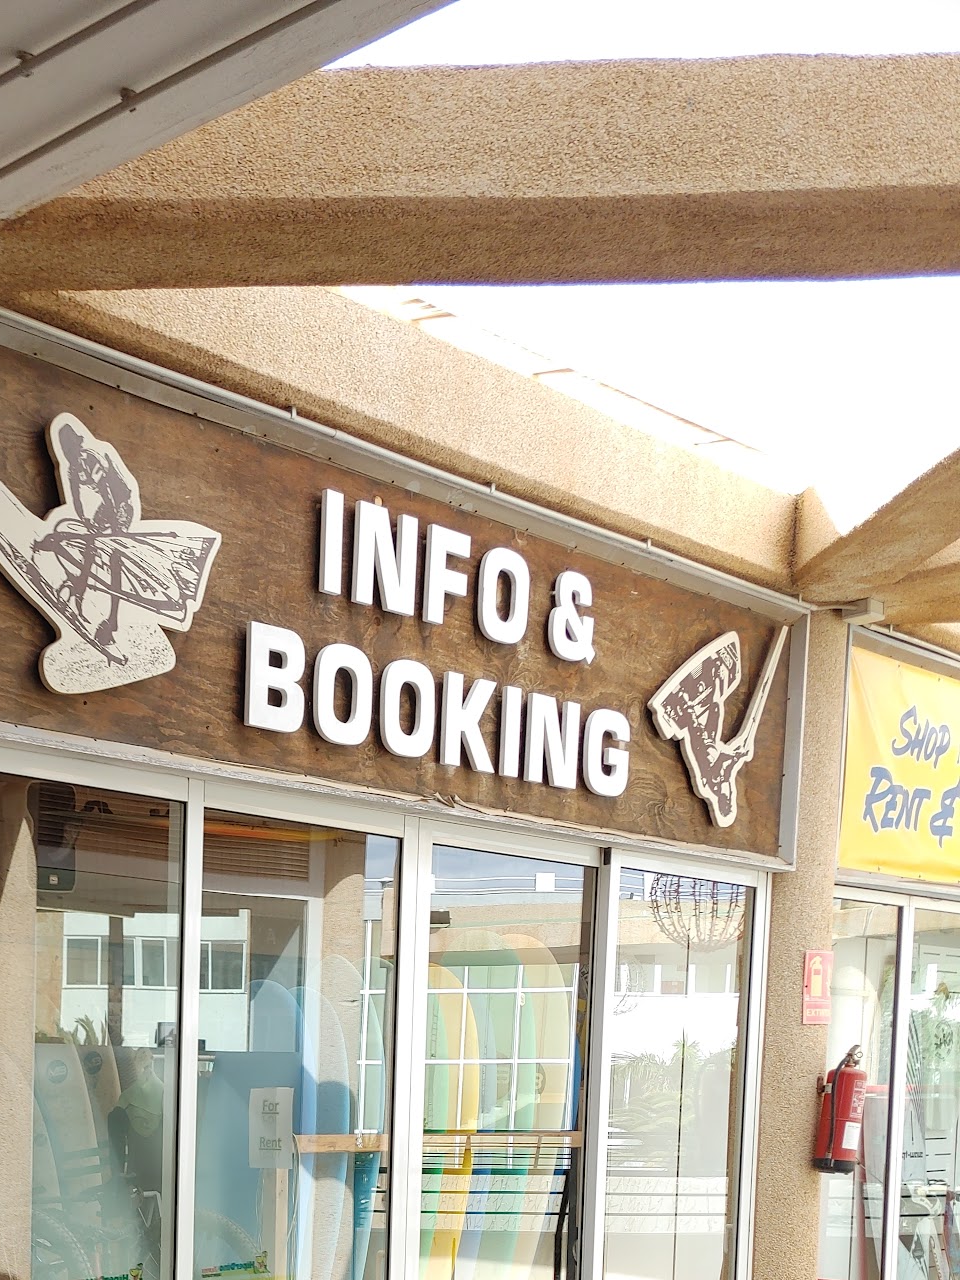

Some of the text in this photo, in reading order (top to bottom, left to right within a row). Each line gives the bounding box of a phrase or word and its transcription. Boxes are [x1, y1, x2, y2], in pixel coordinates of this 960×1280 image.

[319, 488, 596, 663] INFO &
[244, 621, 631, 797] BOOKING
[930, 777, 960, 848] &
[262, 1099, 280, 1113] For
[259, 1136, 282, 1149] Rent
